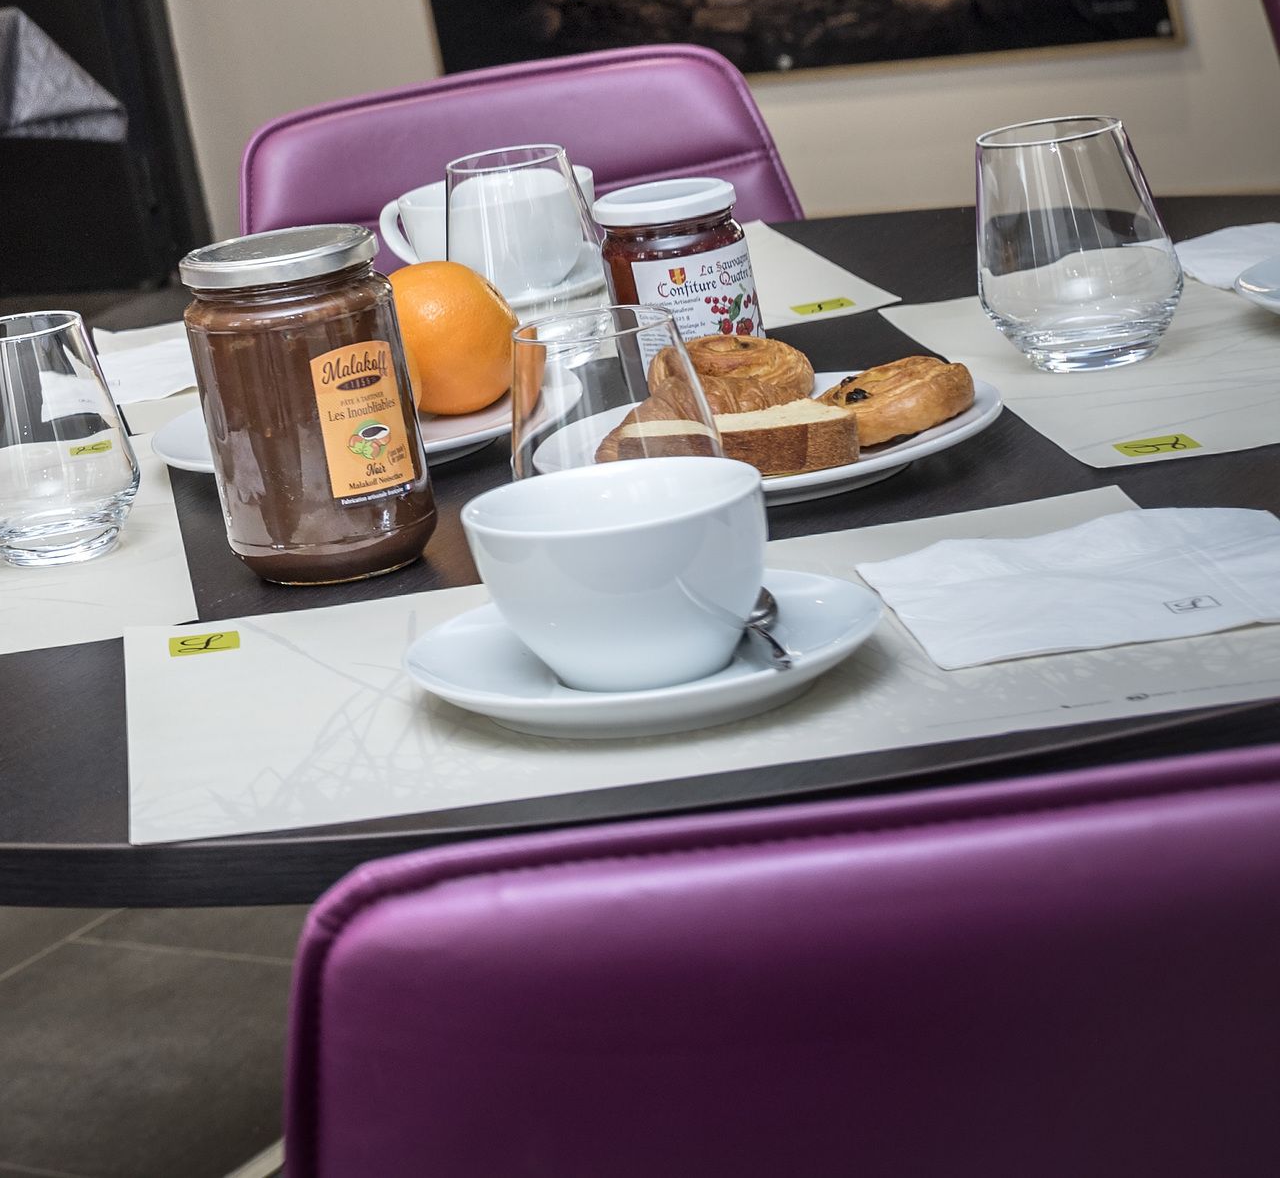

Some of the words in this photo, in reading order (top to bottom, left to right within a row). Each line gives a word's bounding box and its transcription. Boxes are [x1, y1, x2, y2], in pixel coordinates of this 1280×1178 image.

[657, 281, 718, 299] Confiture
[321, 350, 388, 384] Malakoff
[327, 410, 346, 422] Les
[347, 397, 397, 419] Inoubliables
